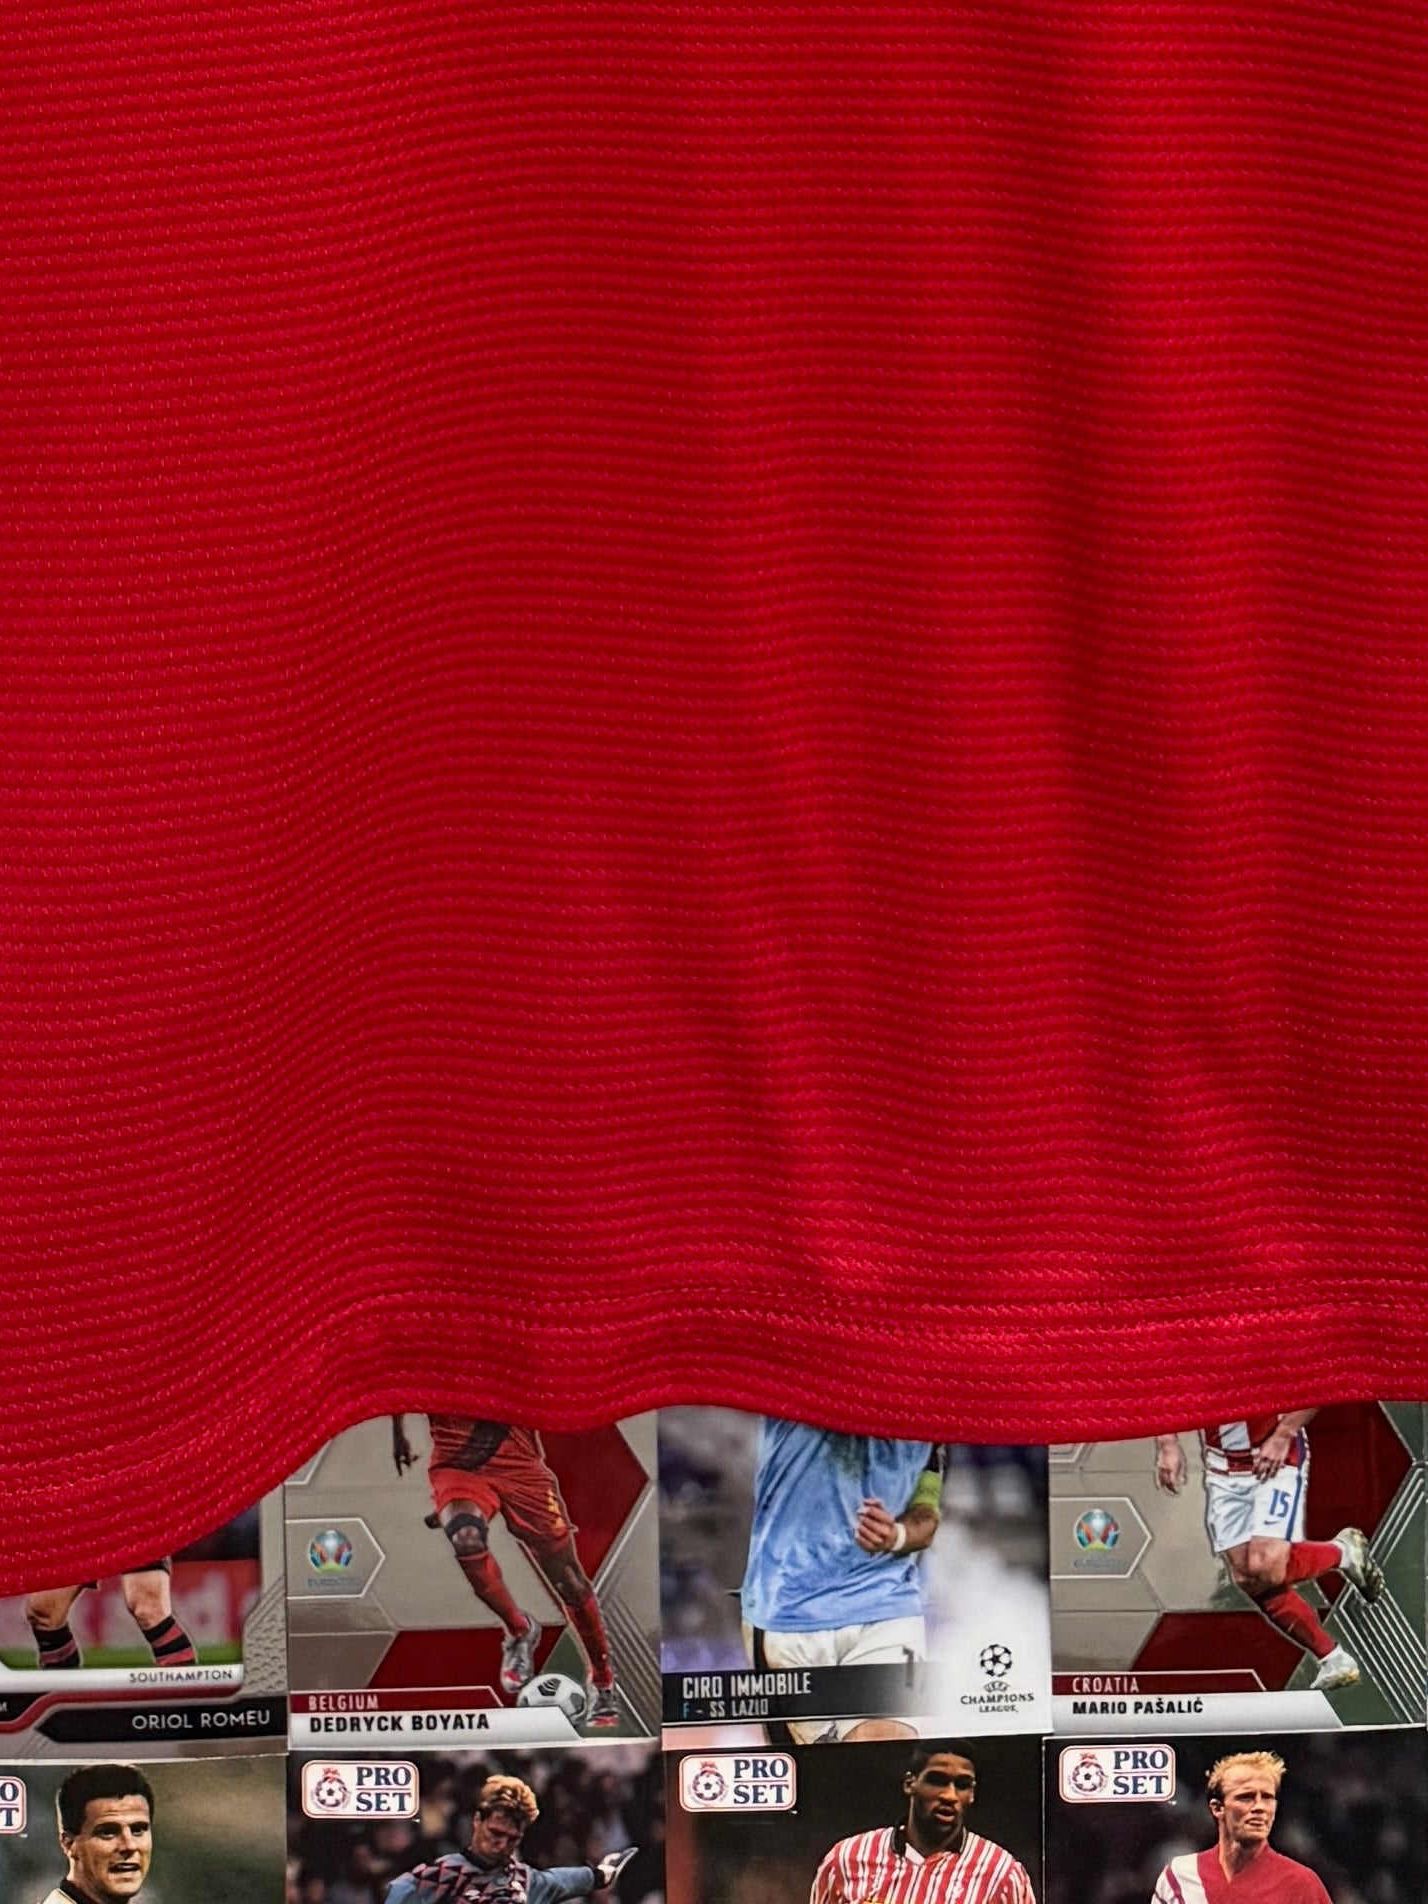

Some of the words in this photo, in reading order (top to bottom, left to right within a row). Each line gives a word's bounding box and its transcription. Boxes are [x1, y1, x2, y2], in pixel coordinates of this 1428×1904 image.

[128, 1670, 233, 1684] SOUTHAMPTON
[681, 1675, 726, 1699] CIRO
[730, 1671, 811, 1696] IMMOBILE
[1072, 1675, 1139, 1695] CROATIA
[308, 1695, 380, 1711] BELGIUM
[1072, 1699, 1129, 1716] MARIO
[131, 1713, 196, 1731] ORIOL
[199, 1707, 270, 1729] ROMEU
[309, 1716, 407, 1733] DEDRYCK
[411, 1713, 490, 1732] BOYATA
[1113, 1750, 1168, 1771] PRO
[355, 1766, 412, 1787] PRO
[1113, 1774, 1169, 1796] SET
[355, 1791, 413, 1813] SET
